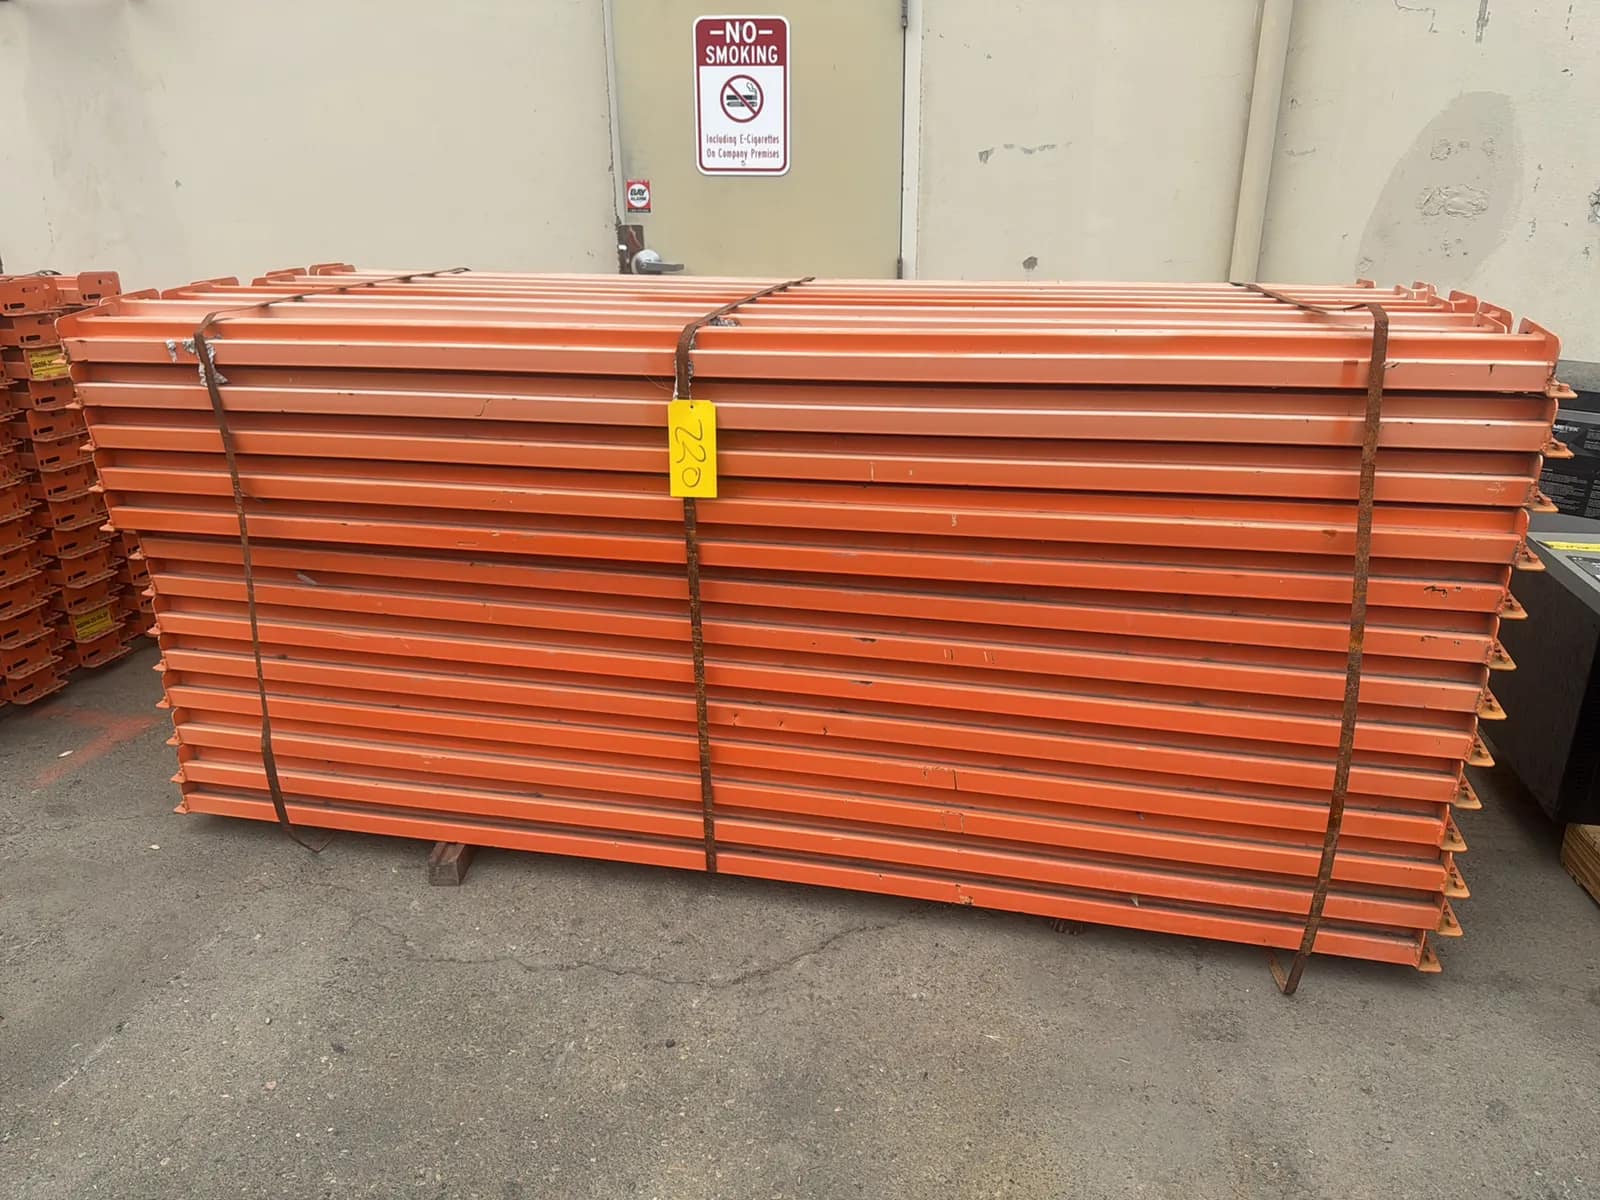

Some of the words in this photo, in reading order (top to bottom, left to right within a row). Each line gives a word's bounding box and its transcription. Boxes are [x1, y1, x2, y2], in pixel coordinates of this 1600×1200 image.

[725, 21, 757, 43] NO
[706, 45, 778, 64] SMOKING
[706, 134, 737, 146] Including
[740, 134, 779, 146] E-Cigarettes
[706, 148, 716, 158] On
[718, 148, 748, 160] Company
[751, 148, 780, 159] Premises
[675, 419, 706, 488] 220
